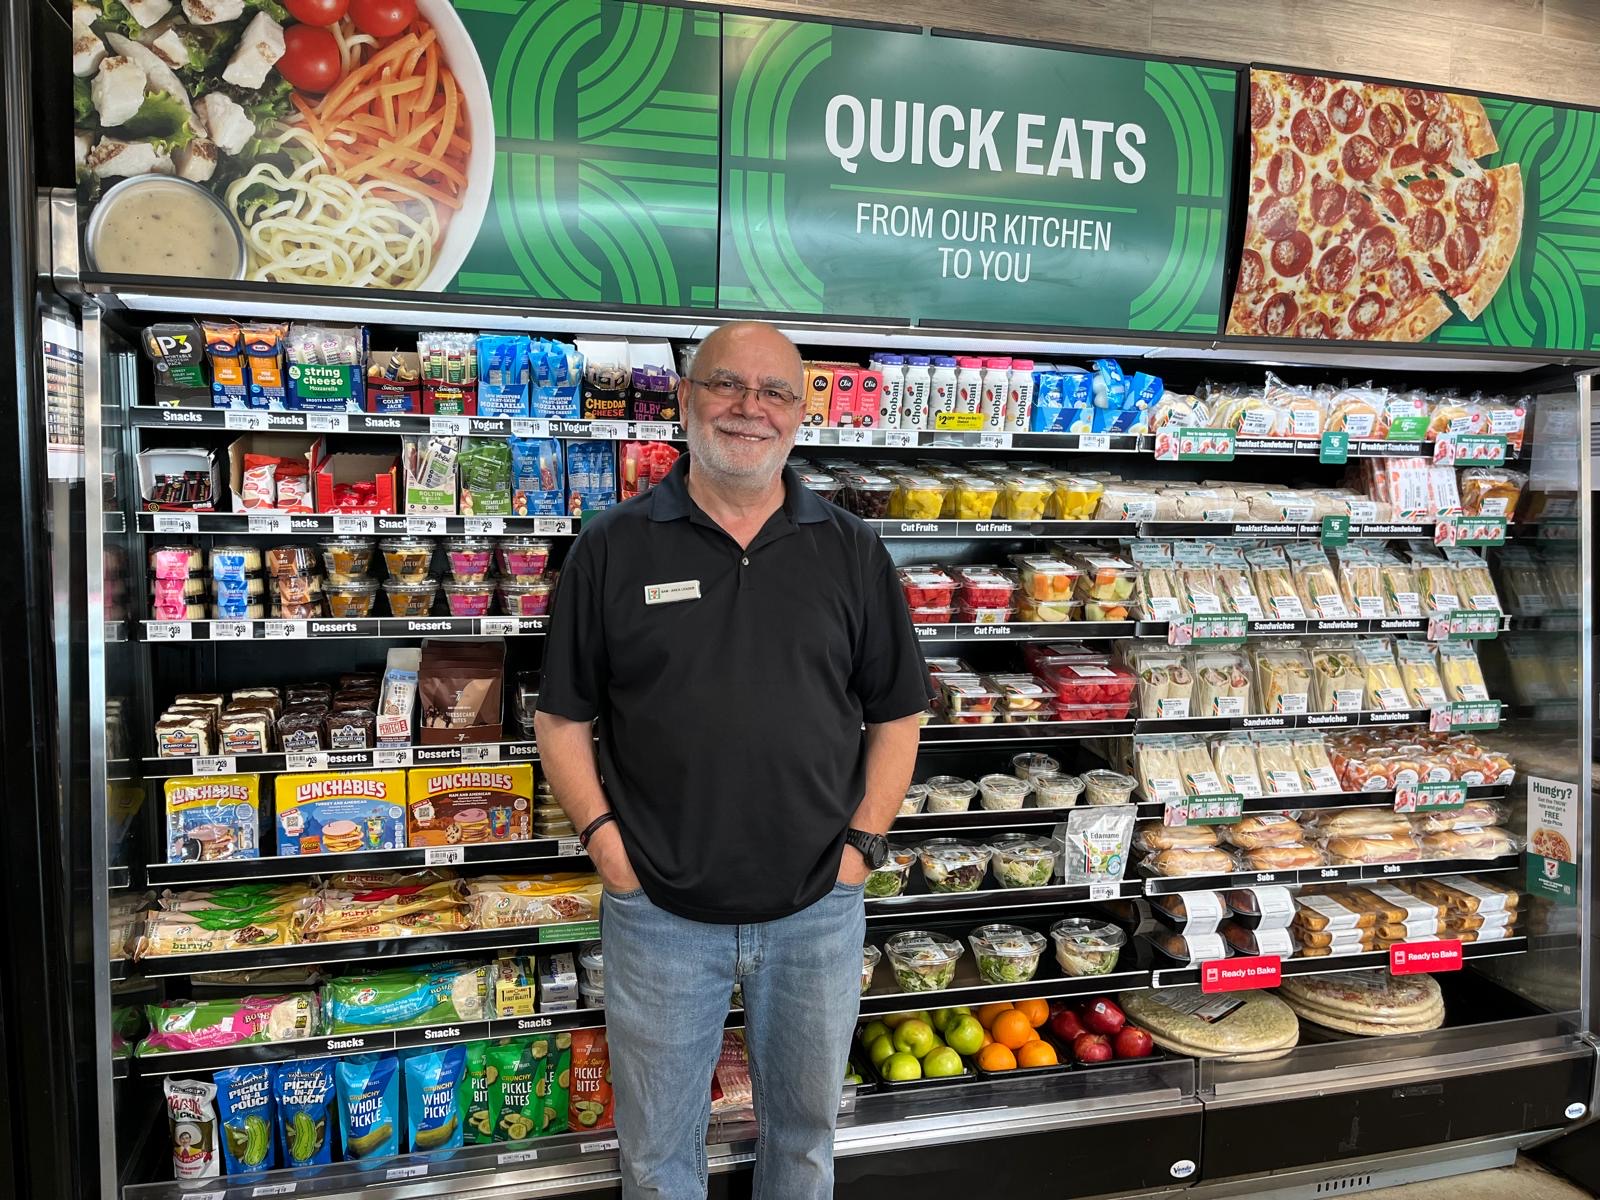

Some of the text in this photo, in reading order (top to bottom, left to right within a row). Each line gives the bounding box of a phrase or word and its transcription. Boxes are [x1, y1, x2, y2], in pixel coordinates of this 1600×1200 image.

[825, 94, 1147, 184] QUICK EATS
[856, 202, 1111, 251] FROM OUR KITCHEN
[938, 247, 1031, 283] TO YOU
[156, 335, 193, 356] P3
[304, 367, 340, 377] string
[303, 375, 344, 386] cheese
[815, 379, 827, 388] Clio
[840, 379, 852, 387] Clio
[864, 380, 876, 389] Clio
[888, 381, 900, 424] Chobani
[945, 383, 954, 412] obani
[967, 383, 977, 413] obani
[585, 398, 626, 410] CHEDDAR
[633, 402, 660, 414] COLBY
[911, 382, 924, 425] Chobani
[991, 384, 1003, 426] Chobani
[1016, 385, 1028, 427] Chobani
[163, 411, 202, 422] Snacks
[592, 409, 625, 417] CHEESE
[267, 415, 304, 425] Snacks
[365, 417, 401, 428] Snacks
[472, 420, 504, 431] Yogurt
[1236, 440, 1259, 448] reakfast
[1361, 442, 1420, 451] Breakfast Sandwiches
[289, 518, 319, 528] nacks
[379, 519, 407, 529] Snack
[901, 524, 938, 532] Cut Fruits
[975, 524, 1012, 532] Cut Fruits
[1235, 525, 1296, 533] Breakfast Sandwiches
[1364, 525, 1422, 533] Breakfast Sandwiches
[312, 622, 357, 632] Desserts
[408, 620, 451, 631] Desserts
[519, 620, 542, 629] serts
[1254, 622, 1295, 630] Sandwiches
[1318, 621, 1358, 629] Sandwiches
[1381, 620, 1420, 628] Sandwiches
[974, 626, 1010, 635] Cut Fruits
[1243, 717, 1285, 727] Sandwiches
[1307, 714, 1348, 723] Sandwiches
[1370, 712, 1410, 721] Sandwiches
[418, 750, 461, 760] Desserts
[509, 745, 537, 755] Desse
[427, 772, 513, 794] LUNCHABLES
[172, 784, 249, 805] LUNCHABLES
[296, 780, 387, 802] LUNCHABLES
[1533, 781, 1572, 800] Hungry?
[1544, 810, 1559, 820] FREE
[1321, 869, 1338, 878] Subs
[1384, 865, 1401, 873] Subs
[347, 873, 384, 882] burrito
[1257, 874, 1275, 882] Subs
[172, 941, 213, 951] burrito
[1408, 950, 1458, 962] Ready to Bake
[1221, 966, 1277, 980] Ready to Bake
[518, 1017, 552, 1029] Snacks
[424, 1028, 460, 1039] Snacks
[327, 1038, 364, 1050] Snacks
[502, 1073, 531, 1081] CRUNCHY
[574, 1067, 603, 1080] PICKLE
[228, 1080, 269, 1100] PICKLE
[284, 1079, 325, 1091] PICKLE
[423, 1081, 454, 1092] CRUNCHY
[502, 1081, 532, 1094] PICKLE
[576, 1080, 600, 1092] BITES
[241, 1091, 260, 1102] IN-A
[282, 1094, 324, 1106] POUCH
[422, 1088, 454, 1105] WHOLE
[474, 1090, 488, 1102] BIT
[505, 1094, 530, 1106] BITES
[348, 1097, 383, 1114] WHOLE
[350, 1110, 381, 1127] PICKLE
